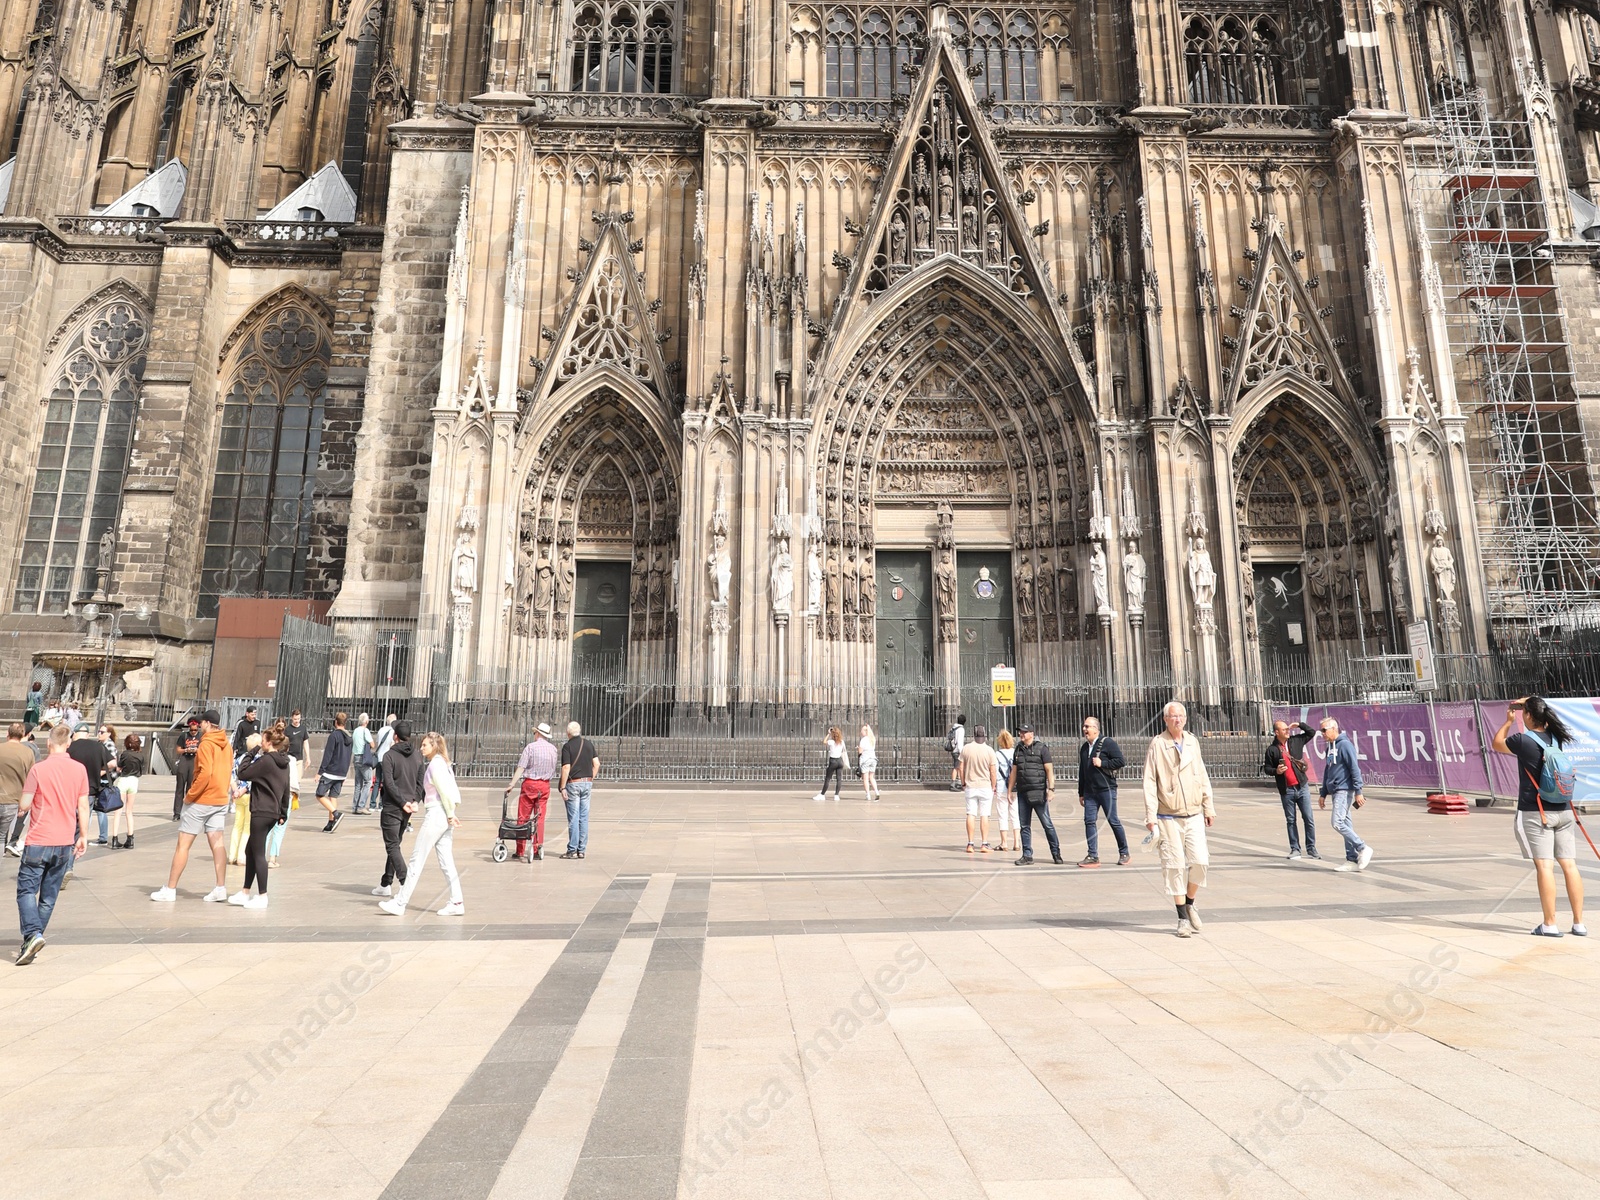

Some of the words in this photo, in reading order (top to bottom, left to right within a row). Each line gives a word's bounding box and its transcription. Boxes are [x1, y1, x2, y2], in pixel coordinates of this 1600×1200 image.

[995, 684, 1005, 693] U1
[1313, 730, 1466, 763] CLTURLIS
[1362, 768, 1395, 786] ultur
